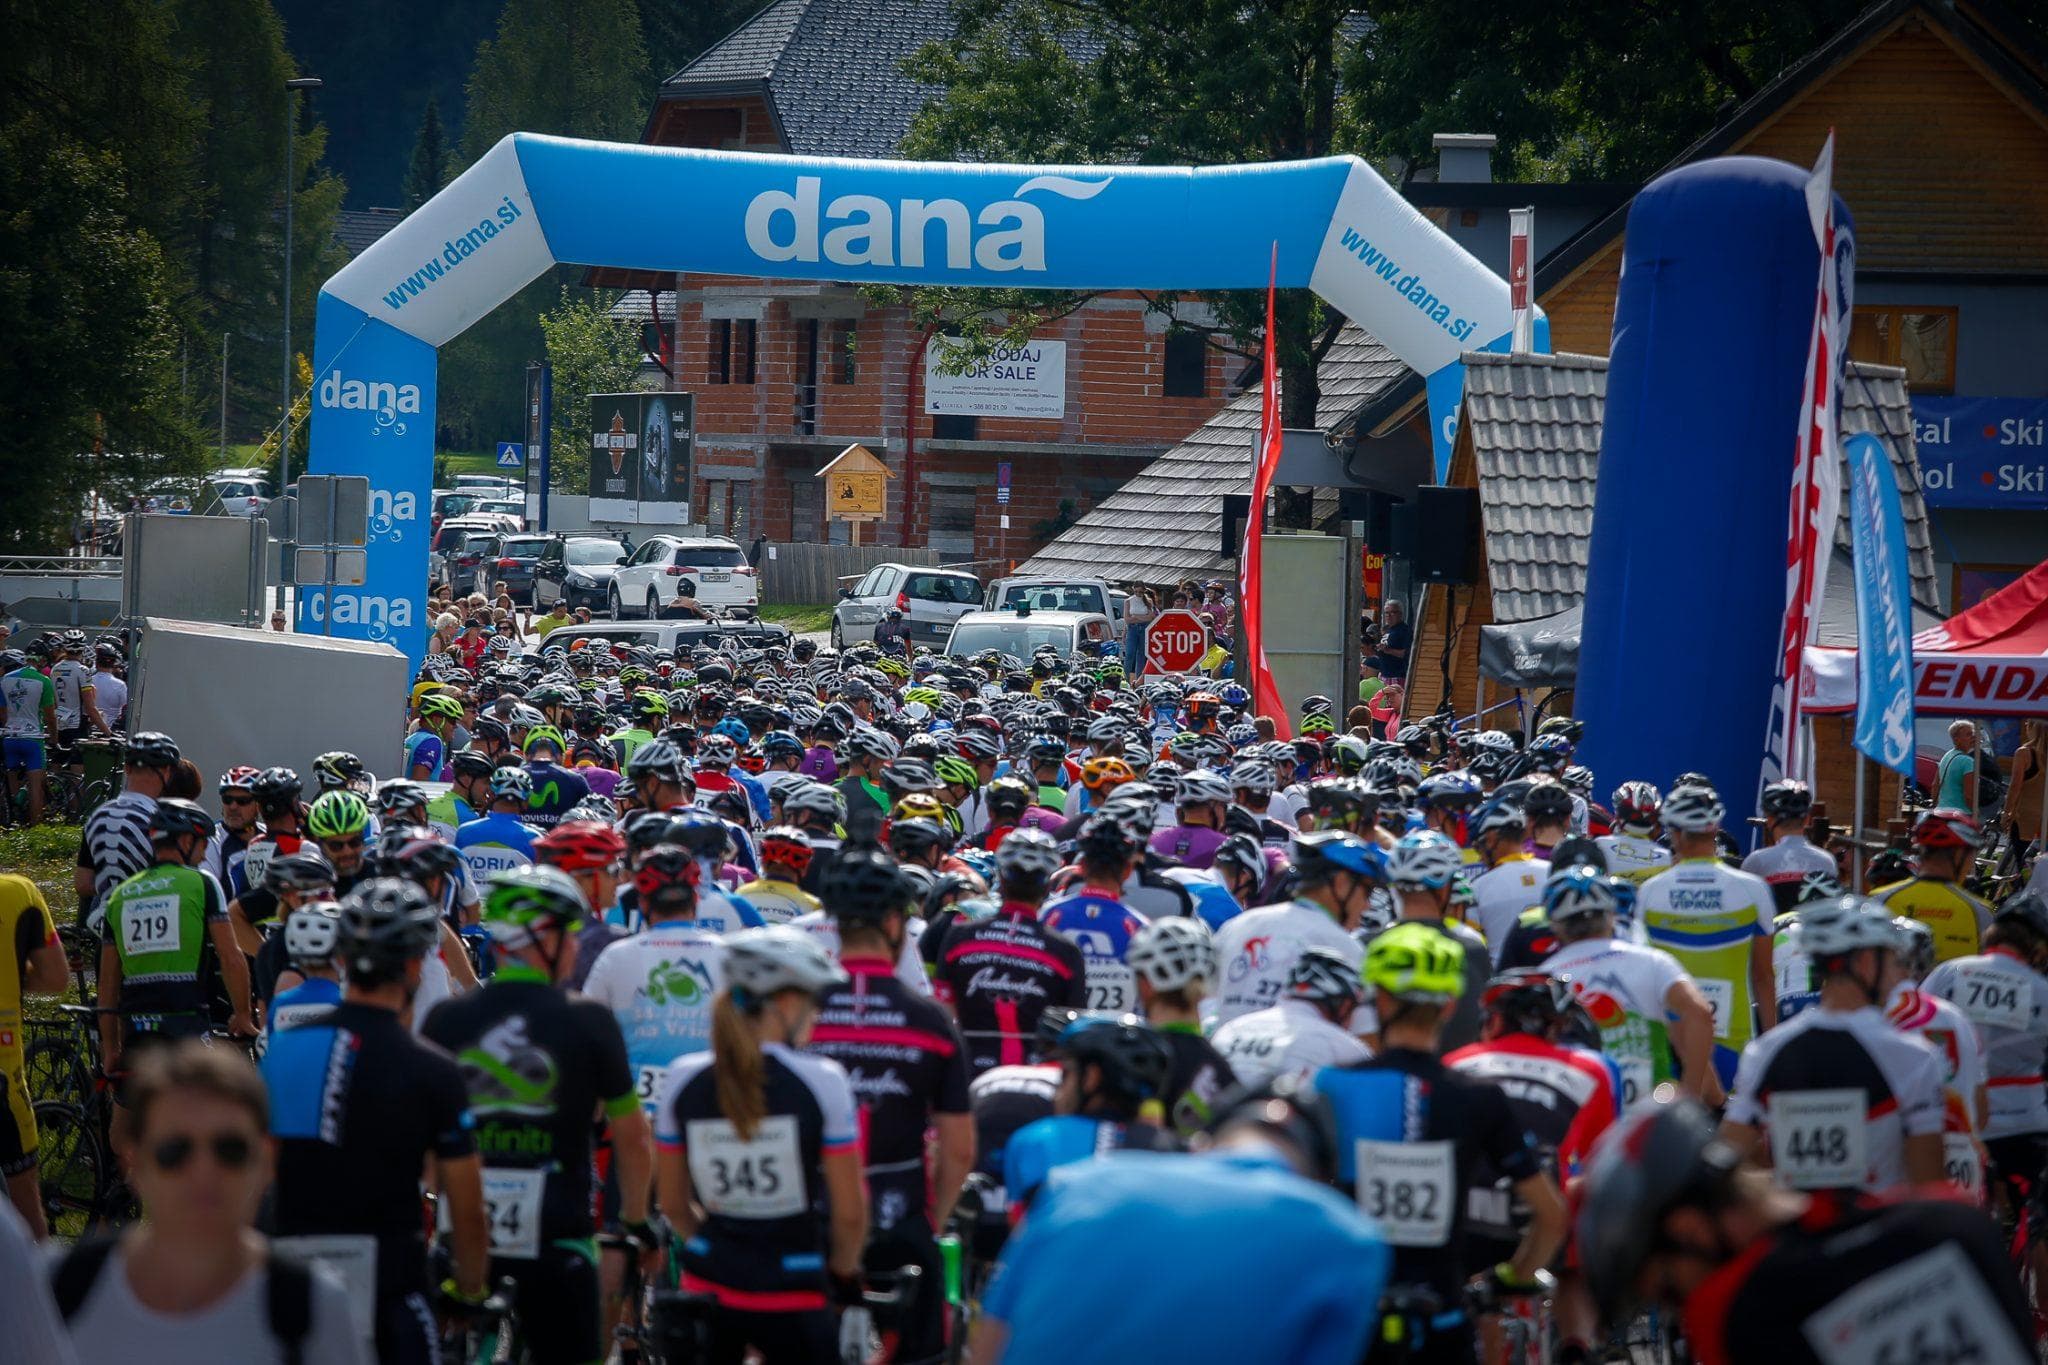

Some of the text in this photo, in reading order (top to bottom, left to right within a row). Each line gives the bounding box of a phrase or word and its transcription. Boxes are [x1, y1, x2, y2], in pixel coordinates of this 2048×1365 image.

[744, 175, 1047, 272] dana
[383, 196, 523, 311] www.dana.si
[1340, 226, 1477, 342] www.dana.si
[986, 347, 1041, 363] RODAJ
[964, 365, 1036, 380] OR SALE
[320, 370, 421, 413] dana
[2000, 418, 2044, 446] Ski
[1998, 464, 2045, 492] Ski
[368, 489, 416, 520] na
[1151, 630, 1202, 655] STOP
[465, 856, 516, 871] YDRIA
[131, 915, 168, 942] 219
[1966, 981, 2018, 1012] 704
[1786, 1125, 1849, 1166] 448
[711, 1155, 780, 1197] 345
[1369, 1177, 1438, 1222] 382
